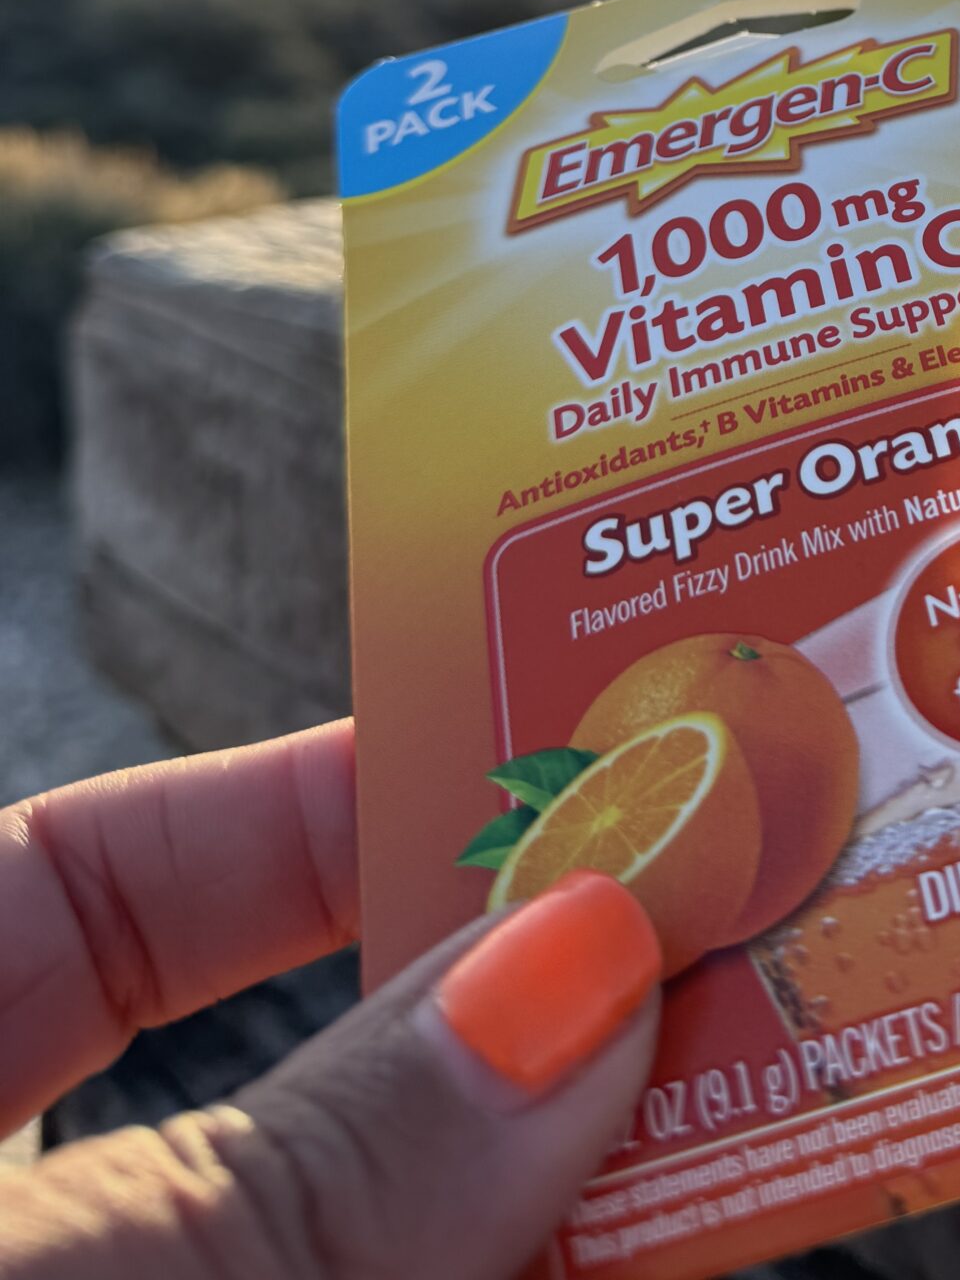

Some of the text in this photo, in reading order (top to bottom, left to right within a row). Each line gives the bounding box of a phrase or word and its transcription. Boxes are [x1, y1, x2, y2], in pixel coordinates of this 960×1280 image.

[365, 84, 498, 155] PACK
[407, 60, 452, 106] 2
[540, 43, 935, 200] Emergen-C
[597, 178, 926, 297] 1,000 mg
[559, 242, 913, 381] Vitamin
[553, 381, 658, 440] Daily
[669, 324, 842, 398] Immune
[716, 411, 739, 436] B
[742, 368, 885, 425] Vitamins
[890, 356, 915, 381] &
[569, 579, 668, 641] Flavored
[672, 564, 729, 603] Fizzy
[734, 538, 798, 582] Drink
[800, 523, 845, 559] Mix
[847, 504, 900, 543] with
[583, 472, 784, 574] Super
[643, 1079, 693, 1142] OZ
[697, 1060, 756, 1131] (9.1
[762, 1047, 798, 1114] g)
[800, 1001, 948, 1091] PACKETS
[618, 1204, 701, 1257] product
[699, 1197, 723, 1228] is
[720, 1187, 761, 1219] not
[757, 1151, 852, 1208] intended
[849, 1150, 871, 1178] to
[628, 1154, 746, 1209] statements
[744, 1144, 795, 1171] have
[795, 1125, 833, 1155] not
[832, 1111, 882, 1144] been
